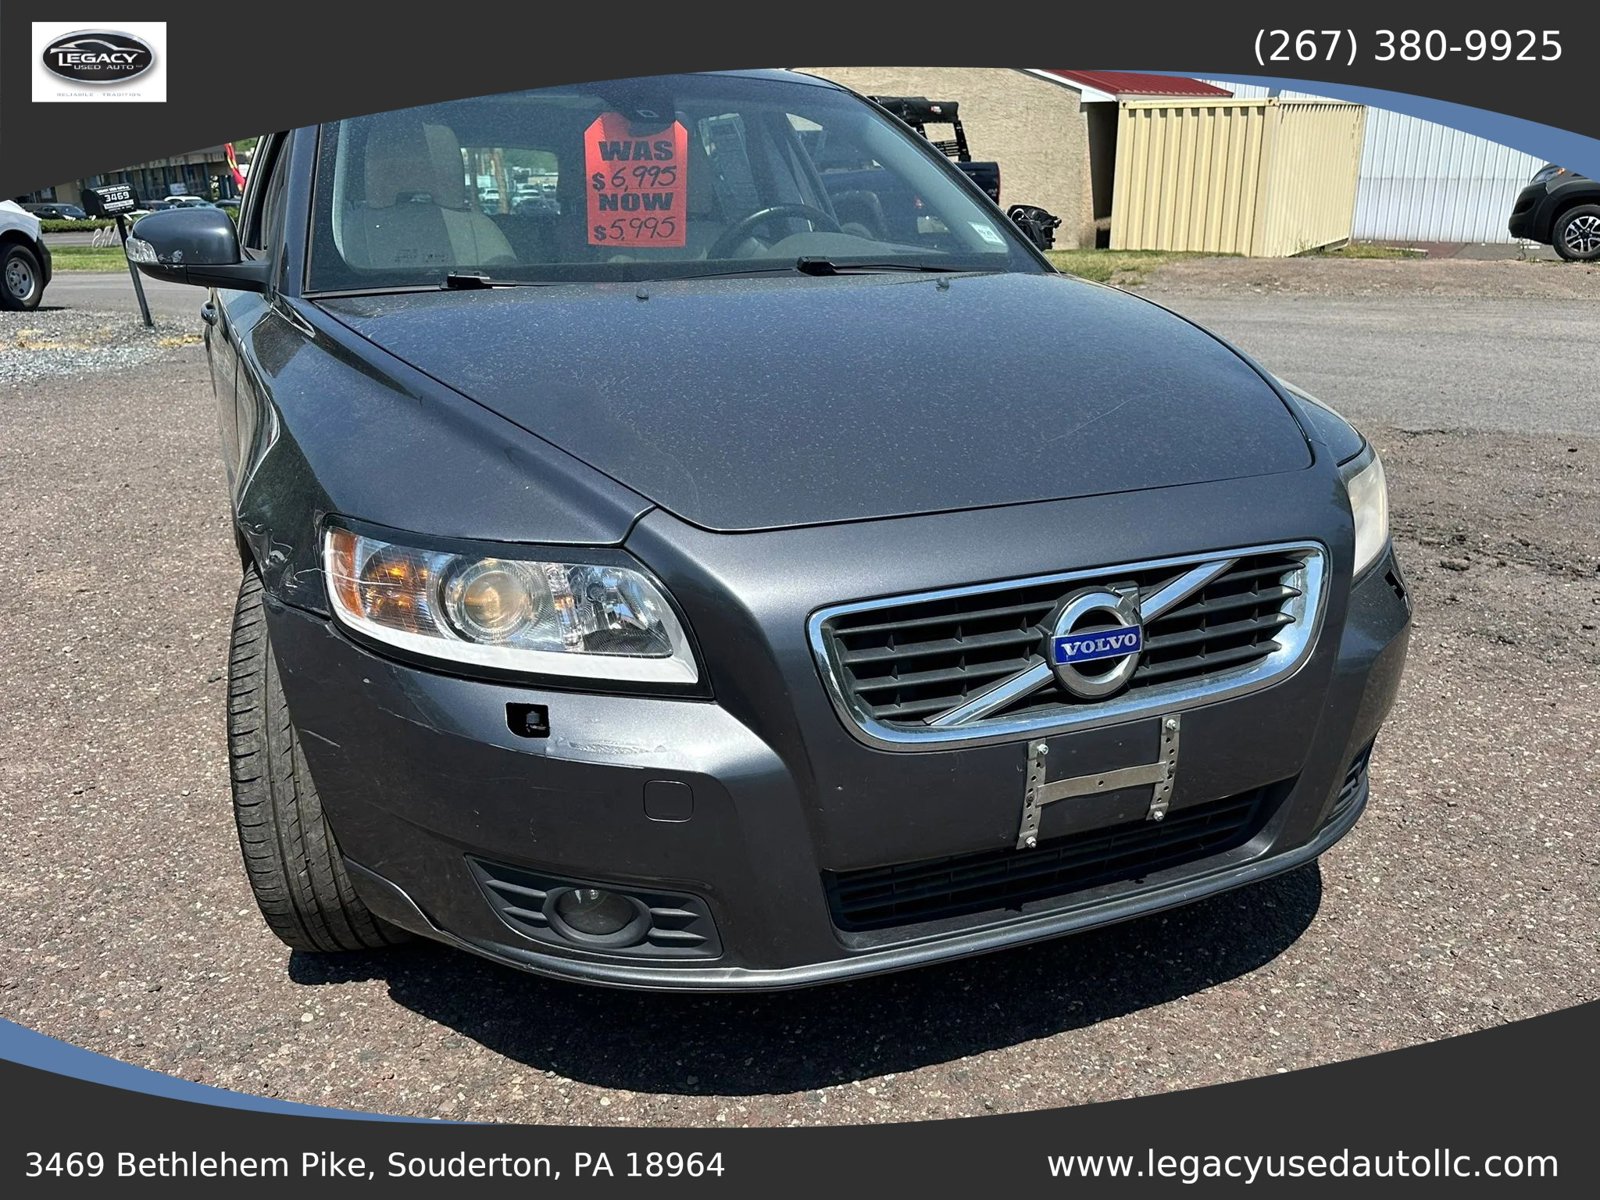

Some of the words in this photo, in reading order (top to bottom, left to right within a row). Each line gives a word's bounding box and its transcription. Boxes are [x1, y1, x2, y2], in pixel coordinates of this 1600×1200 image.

[599, 140, 674, 162] WAS
[104, 191, 130, 203] 3469
[598, 192, 674, 212] NOW
[1061, 633, 1137, 656] VOLVO
